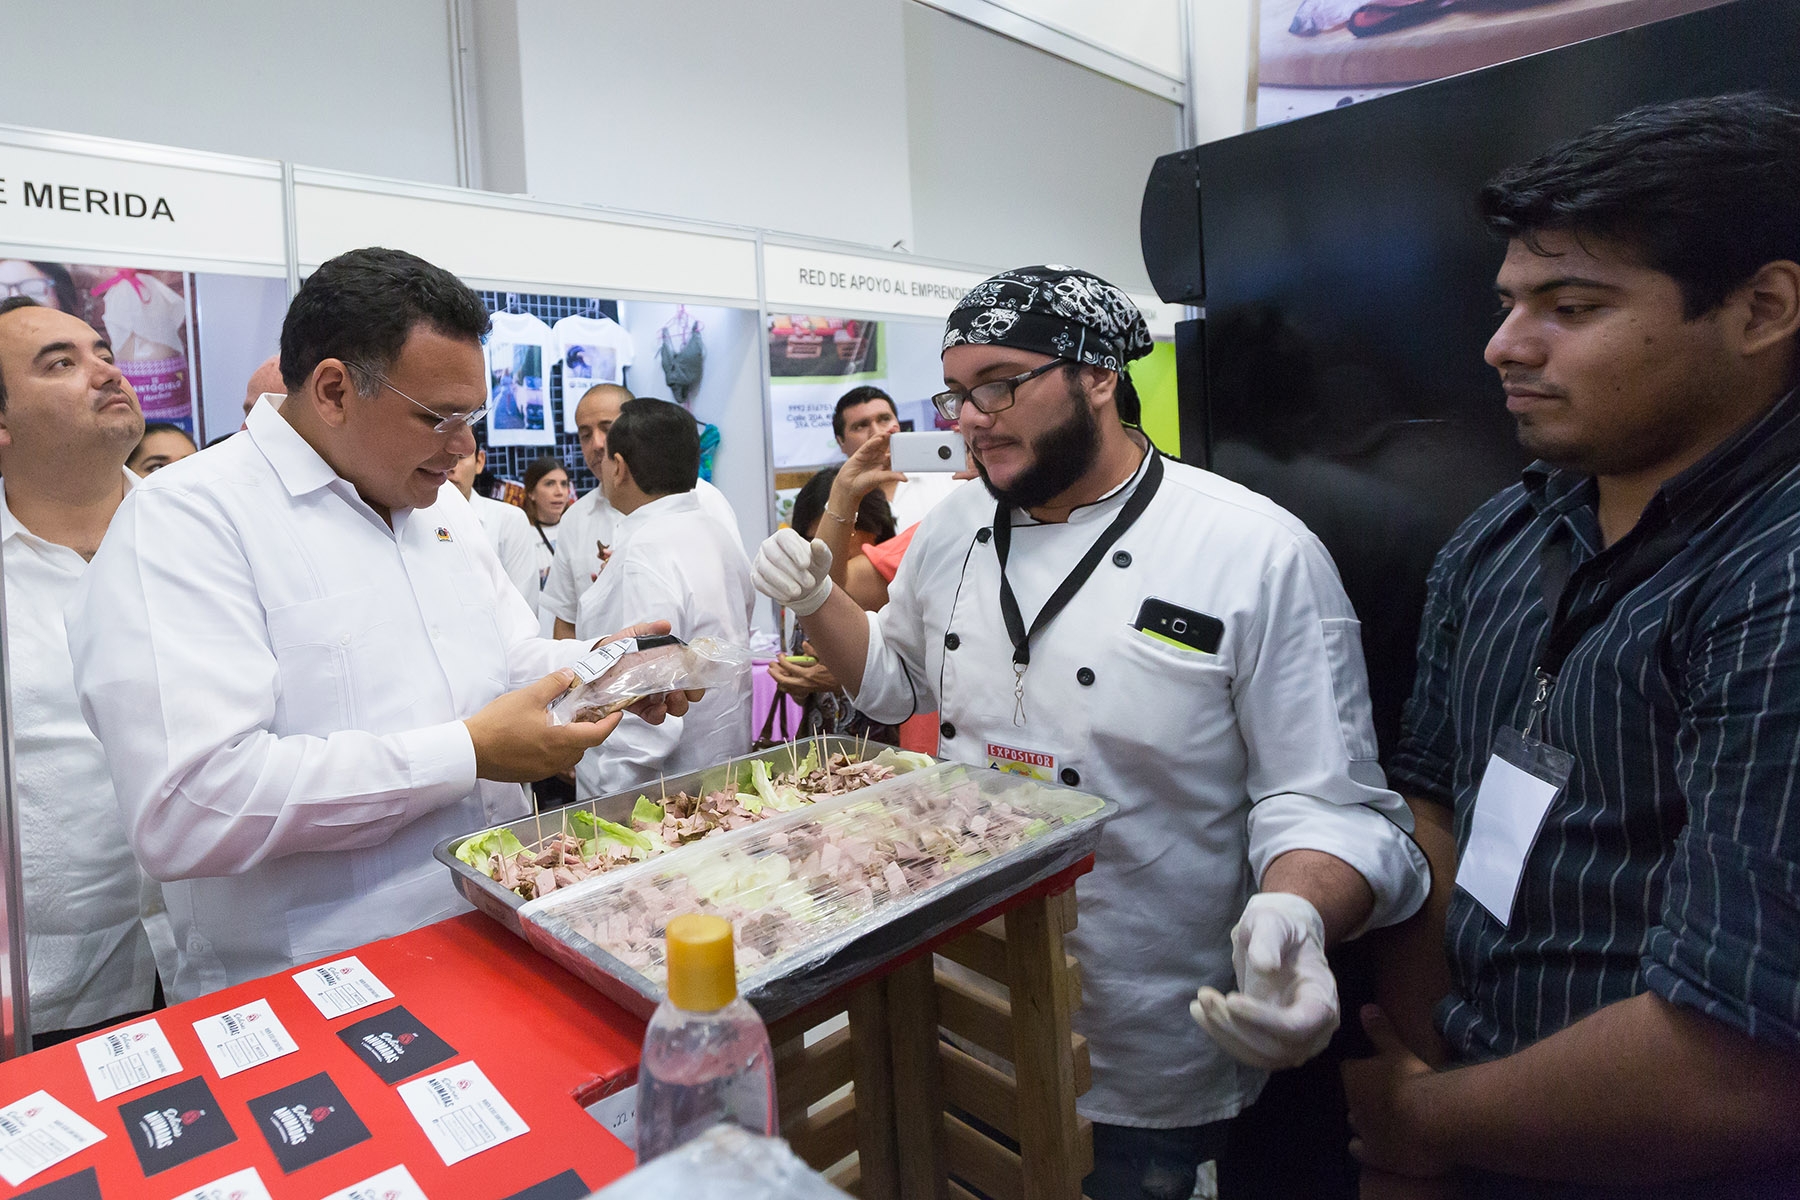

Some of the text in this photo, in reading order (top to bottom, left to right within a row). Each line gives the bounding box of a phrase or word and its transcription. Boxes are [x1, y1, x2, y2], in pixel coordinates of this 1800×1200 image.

[23, 180, 175, 222] MERIDA
[799, 267, 972, 302] RED DE APOYO AL EMPRENDE
[990, 745, 1051, 767] EXPOSITOR
[317, 967, 337, 987] AHUMADAS
[221, 1013, 241, 1037] AHUMADAS
[107, 1034, 124, 1057] AHUMADAS
[427, 1078, 455, 1108] AHUMADAS
